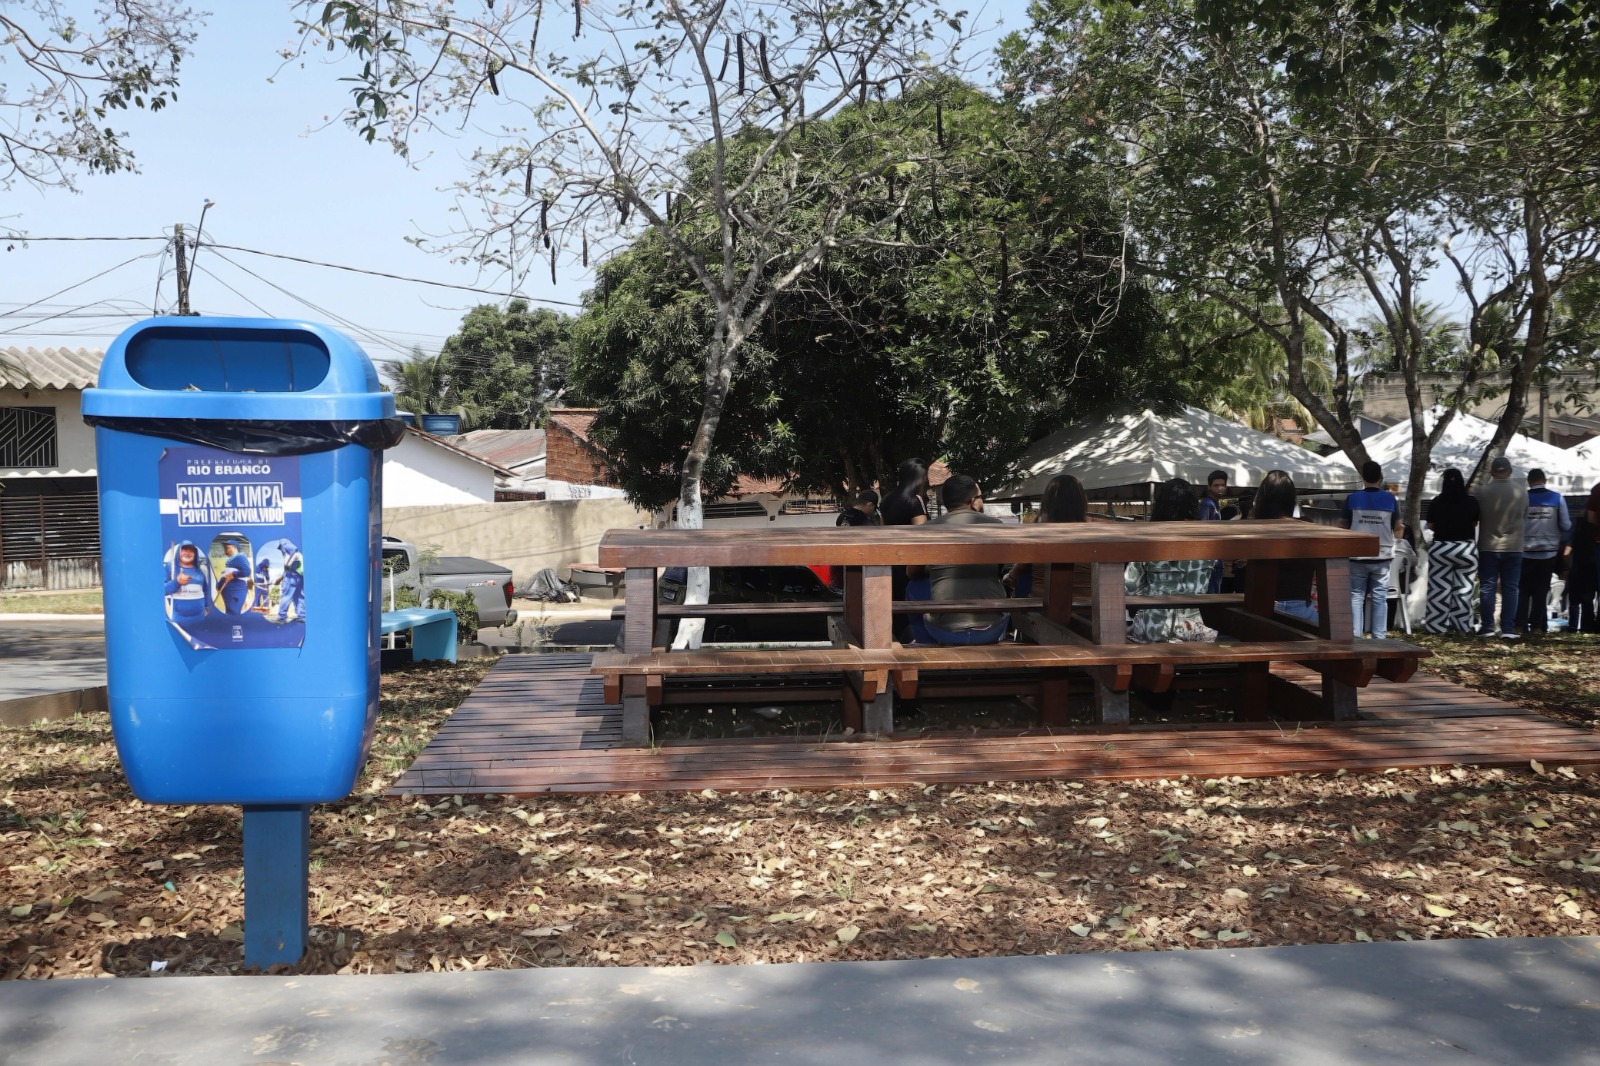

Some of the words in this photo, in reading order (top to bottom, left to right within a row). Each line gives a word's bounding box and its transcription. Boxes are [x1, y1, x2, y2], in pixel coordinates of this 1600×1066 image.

[187, 465, 211, 475] RIO
[214, 465, 271, 475] BRANCO
[179, 486, 232, 508] CIDADE
[235, 485, 283, 508] LIMPA
[182, 509, 209, 523] POVO
[210, 508, 283, 523] DESENVOLVIDO
